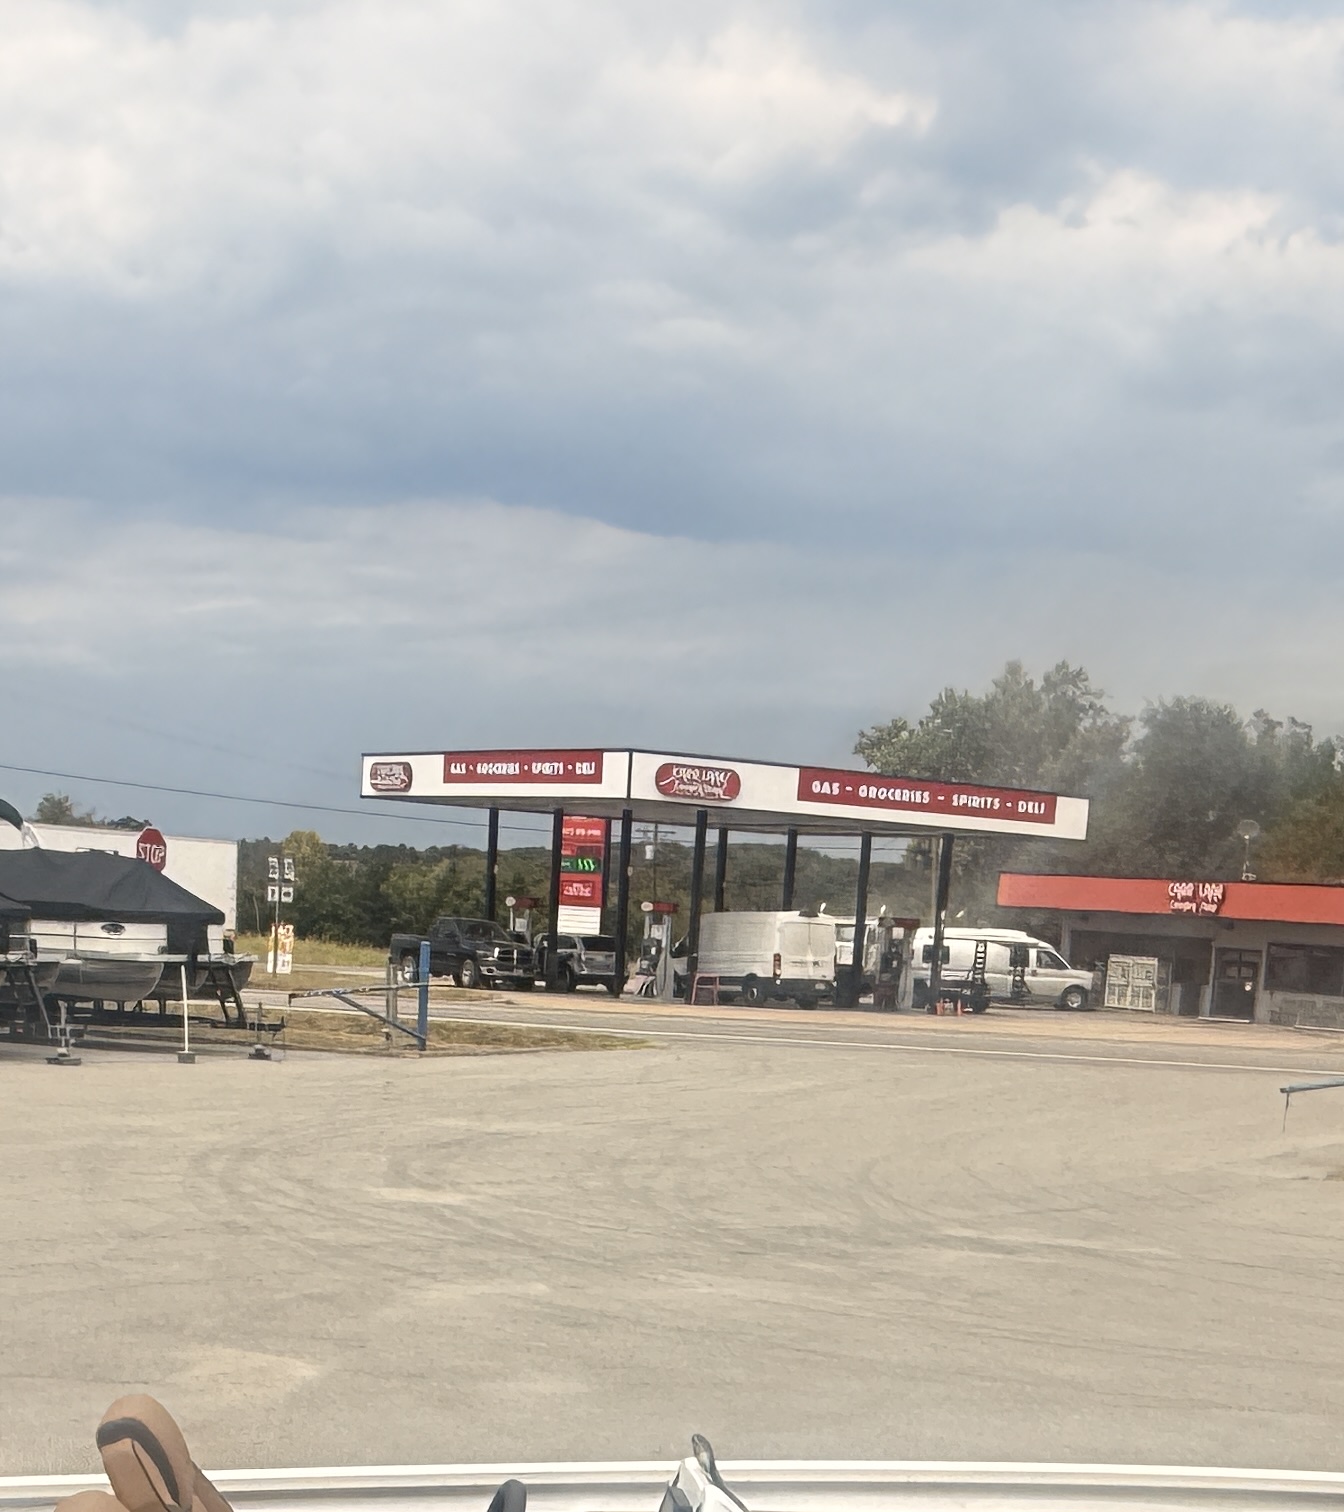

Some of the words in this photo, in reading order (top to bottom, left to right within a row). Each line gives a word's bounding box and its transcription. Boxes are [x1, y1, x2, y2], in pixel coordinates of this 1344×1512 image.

[812, 780, 840, 796] GAS
[858, 784, 930, 804] GROCERIES
[952, 793, 1001, 811] SPIRITS
[1017, 800, 1046, 815] DELI
[138, 842, 165, 864] STOP
